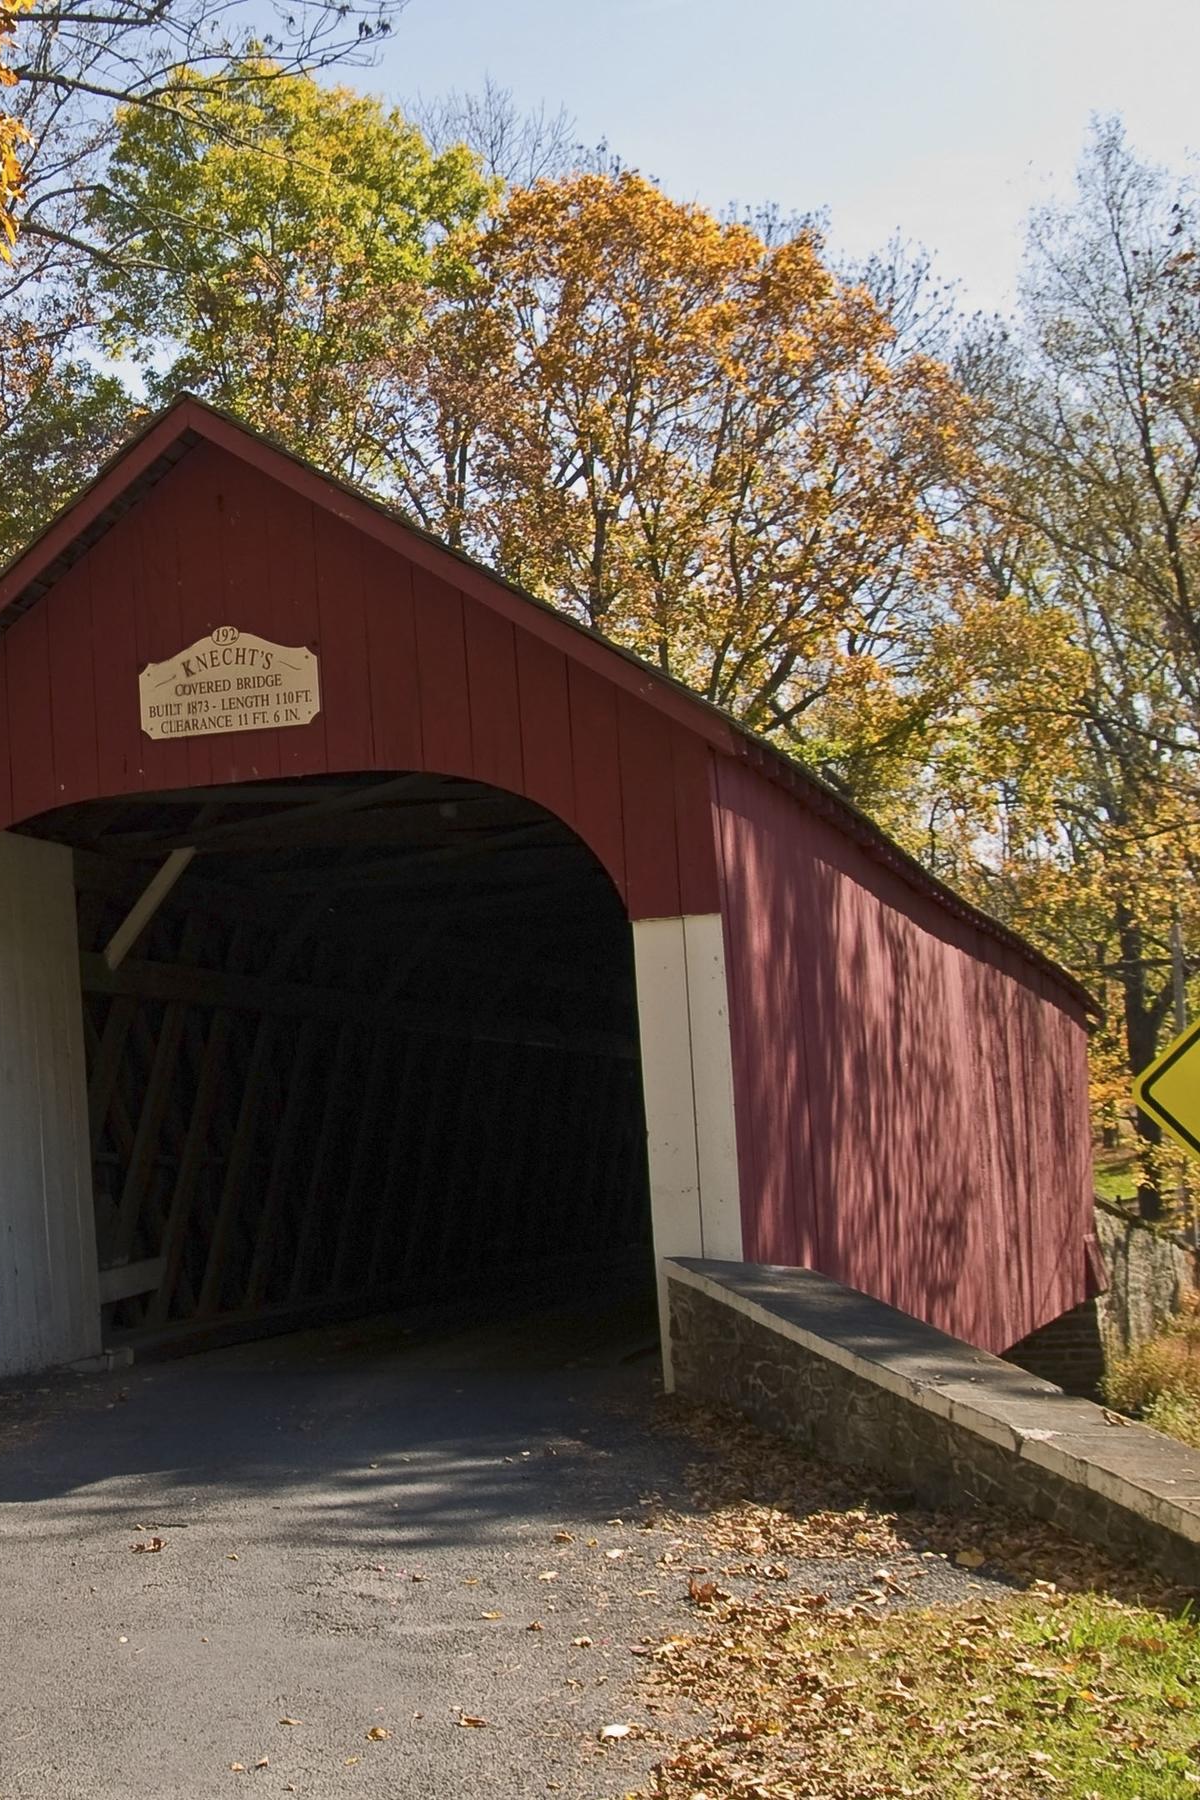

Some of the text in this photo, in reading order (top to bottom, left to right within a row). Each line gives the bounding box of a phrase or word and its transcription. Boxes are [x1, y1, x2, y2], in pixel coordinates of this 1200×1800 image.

[215, 628, 237, 643] 192
[181, 648, 274, 677] KNECHT'S
[175, 674, 283, 697] COVERED BRIDGE
[149, 703, 183, 718] BUILT
[187, 700, 210, 716] 1873
[221, 694, 270, 711] LENGTH
[160, 708, 300, 734] CLEARANCE 11 FT. 6 IN.
